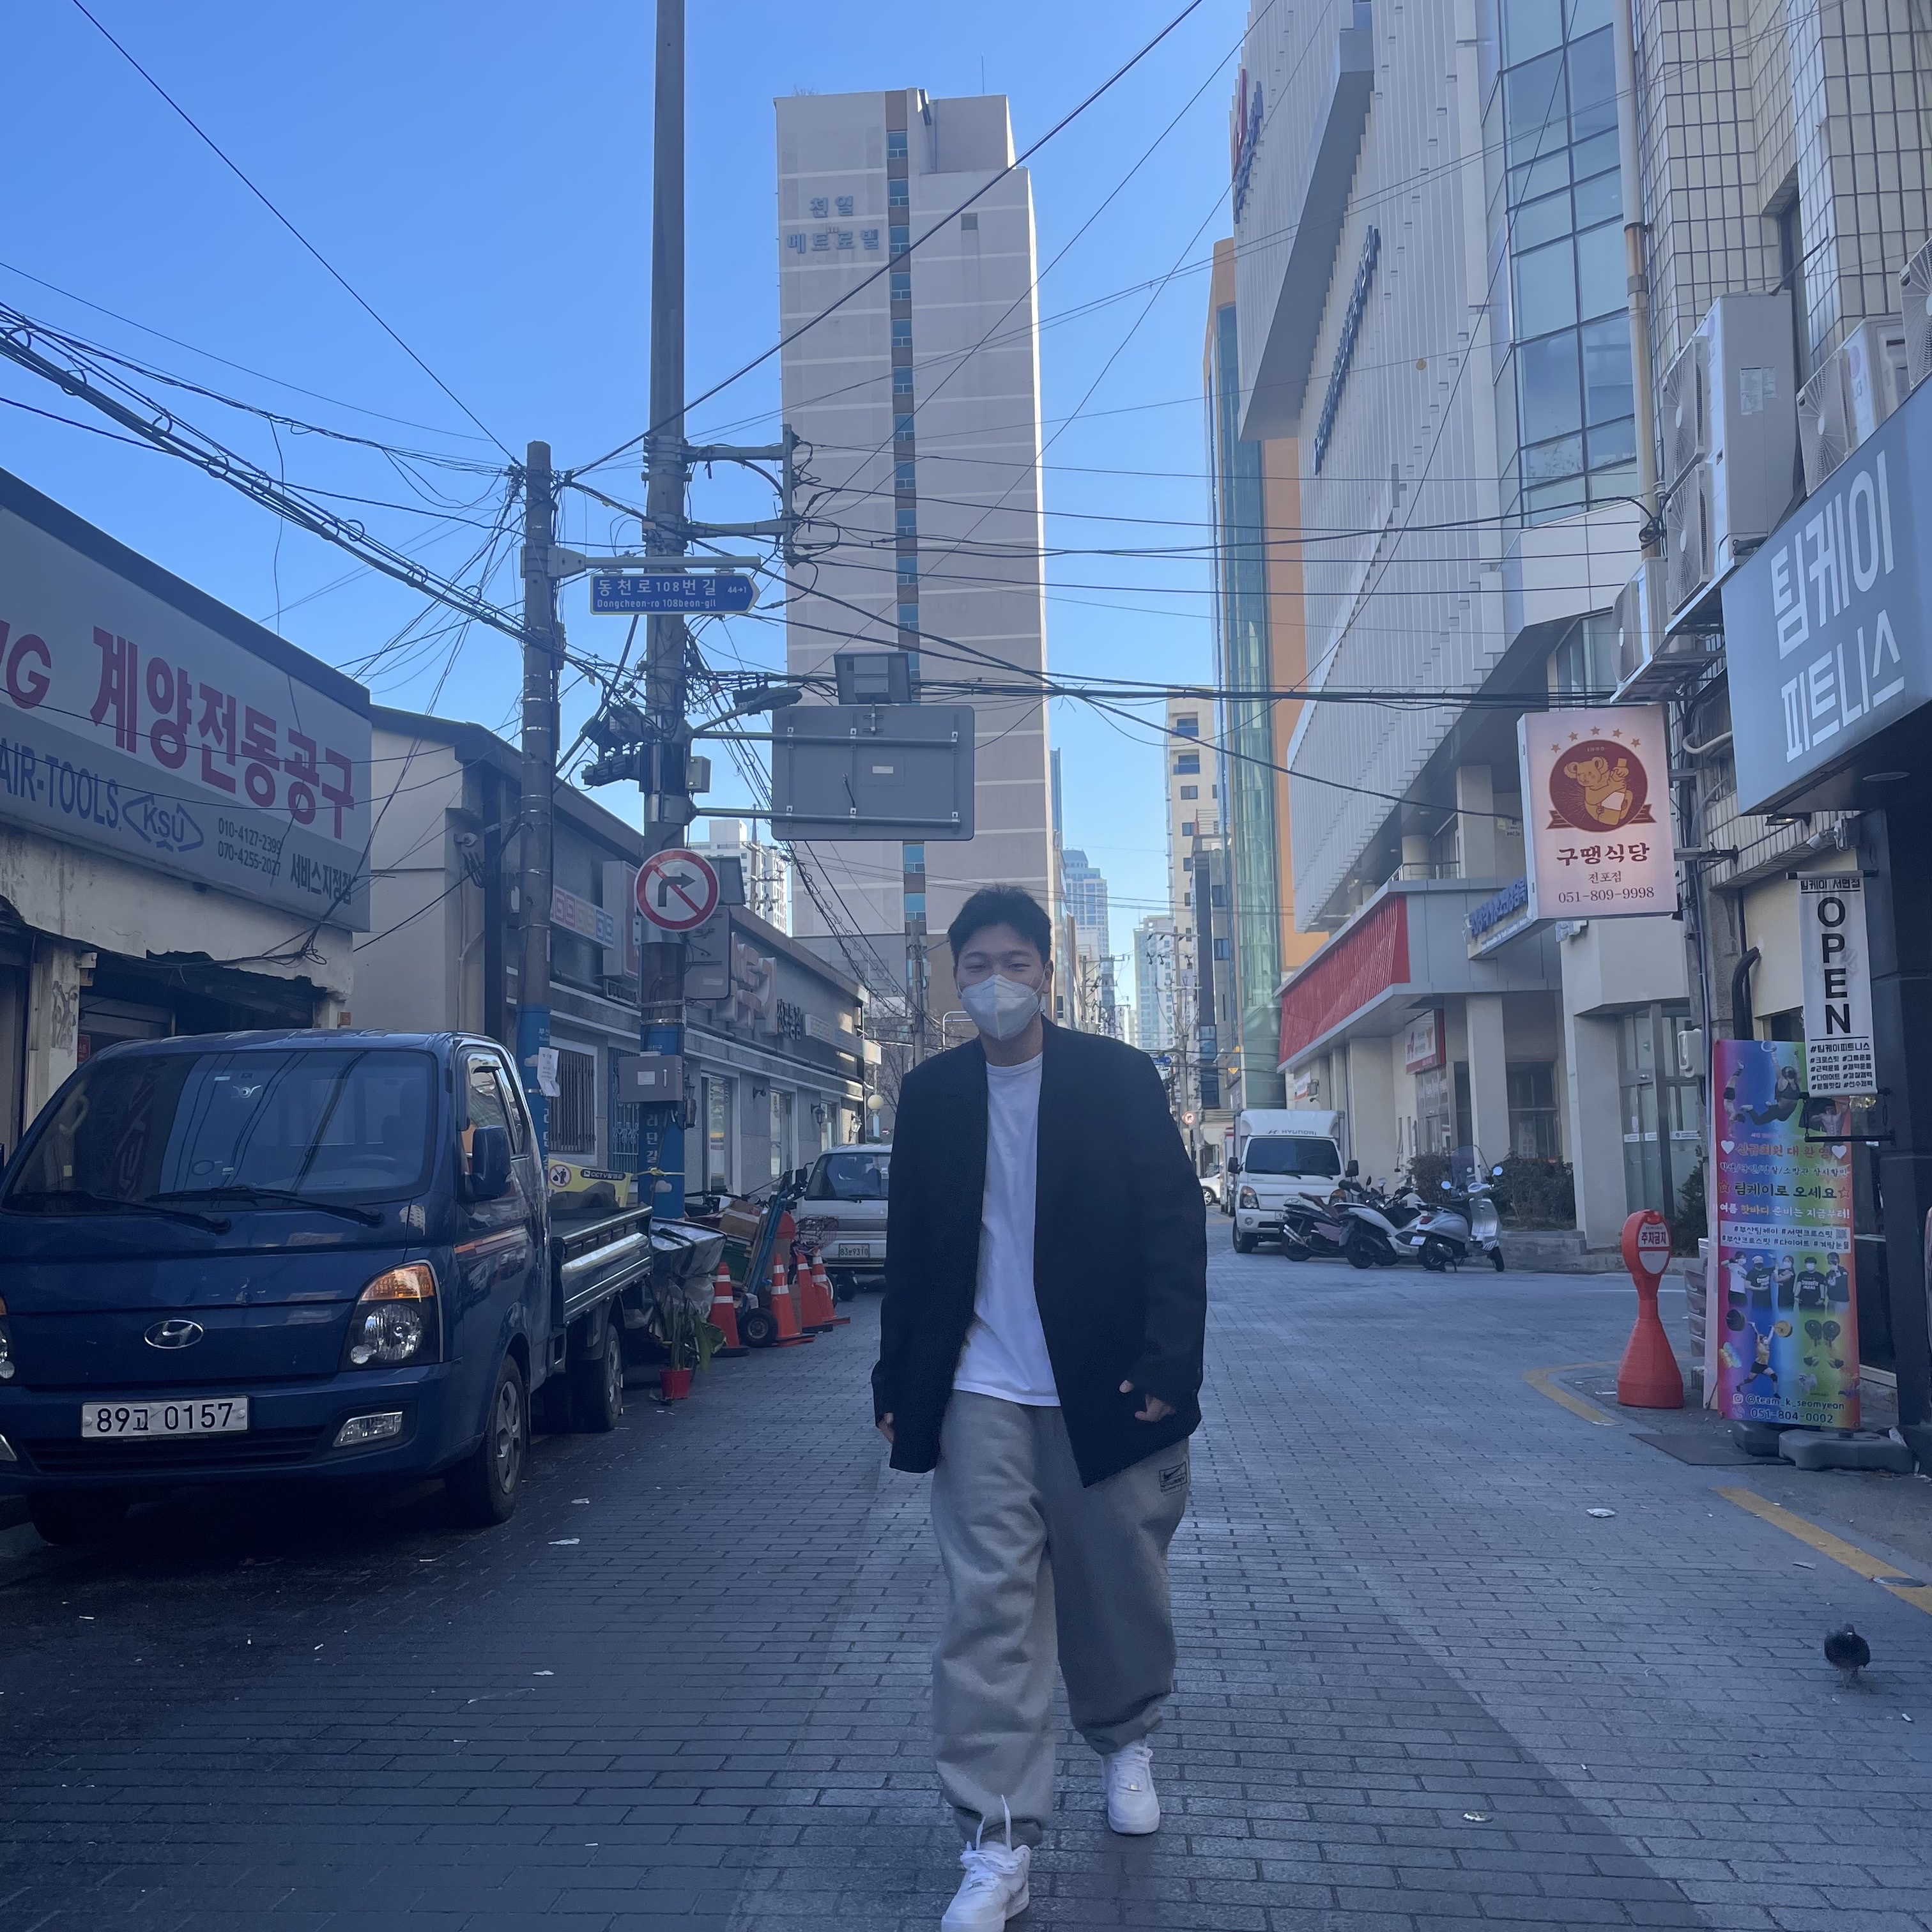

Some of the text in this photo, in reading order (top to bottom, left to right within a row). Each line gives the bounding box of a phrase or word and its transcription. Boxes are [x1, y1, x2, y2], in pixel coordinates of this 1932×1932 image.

[787, 229, 879, 254] 메트로빌
[1771, 450, 1894, 659] 팀케이
[597, 579, 716, 597] 동천로108번길
[597, 598, 716, 610] Dongcheon-ro 108beon-gil
[1781, 610, 1905, 763] 피트니스
[89, 625, 355, 840] 계양전동공구
[143, 803, 185, 843] KSU
[218, 818, 282, 854] 010-4127-2399
[1556, 843, 1650, 866] 구땡식당
[290, 853, 352, 906] 서비스지정점
[1588, 871, 1623, 884] 전포점
[1558, 887, 1655, 903] 051-809-9998
[1818, 896, 1851, 1034] OPEN
[1810, 1042, 1870, 1053] #팀케이피트니스
[1736, 1142, 1783, 1157] 신규회원
[1734, 1181, 1837, 1200] 팀케이로 오세요
[1719, 1203, 1738, 1215] 여름
[164, 1402, 233, 1430] 0157
[1751, 1408, 1834, 1424] 051-804-0002
